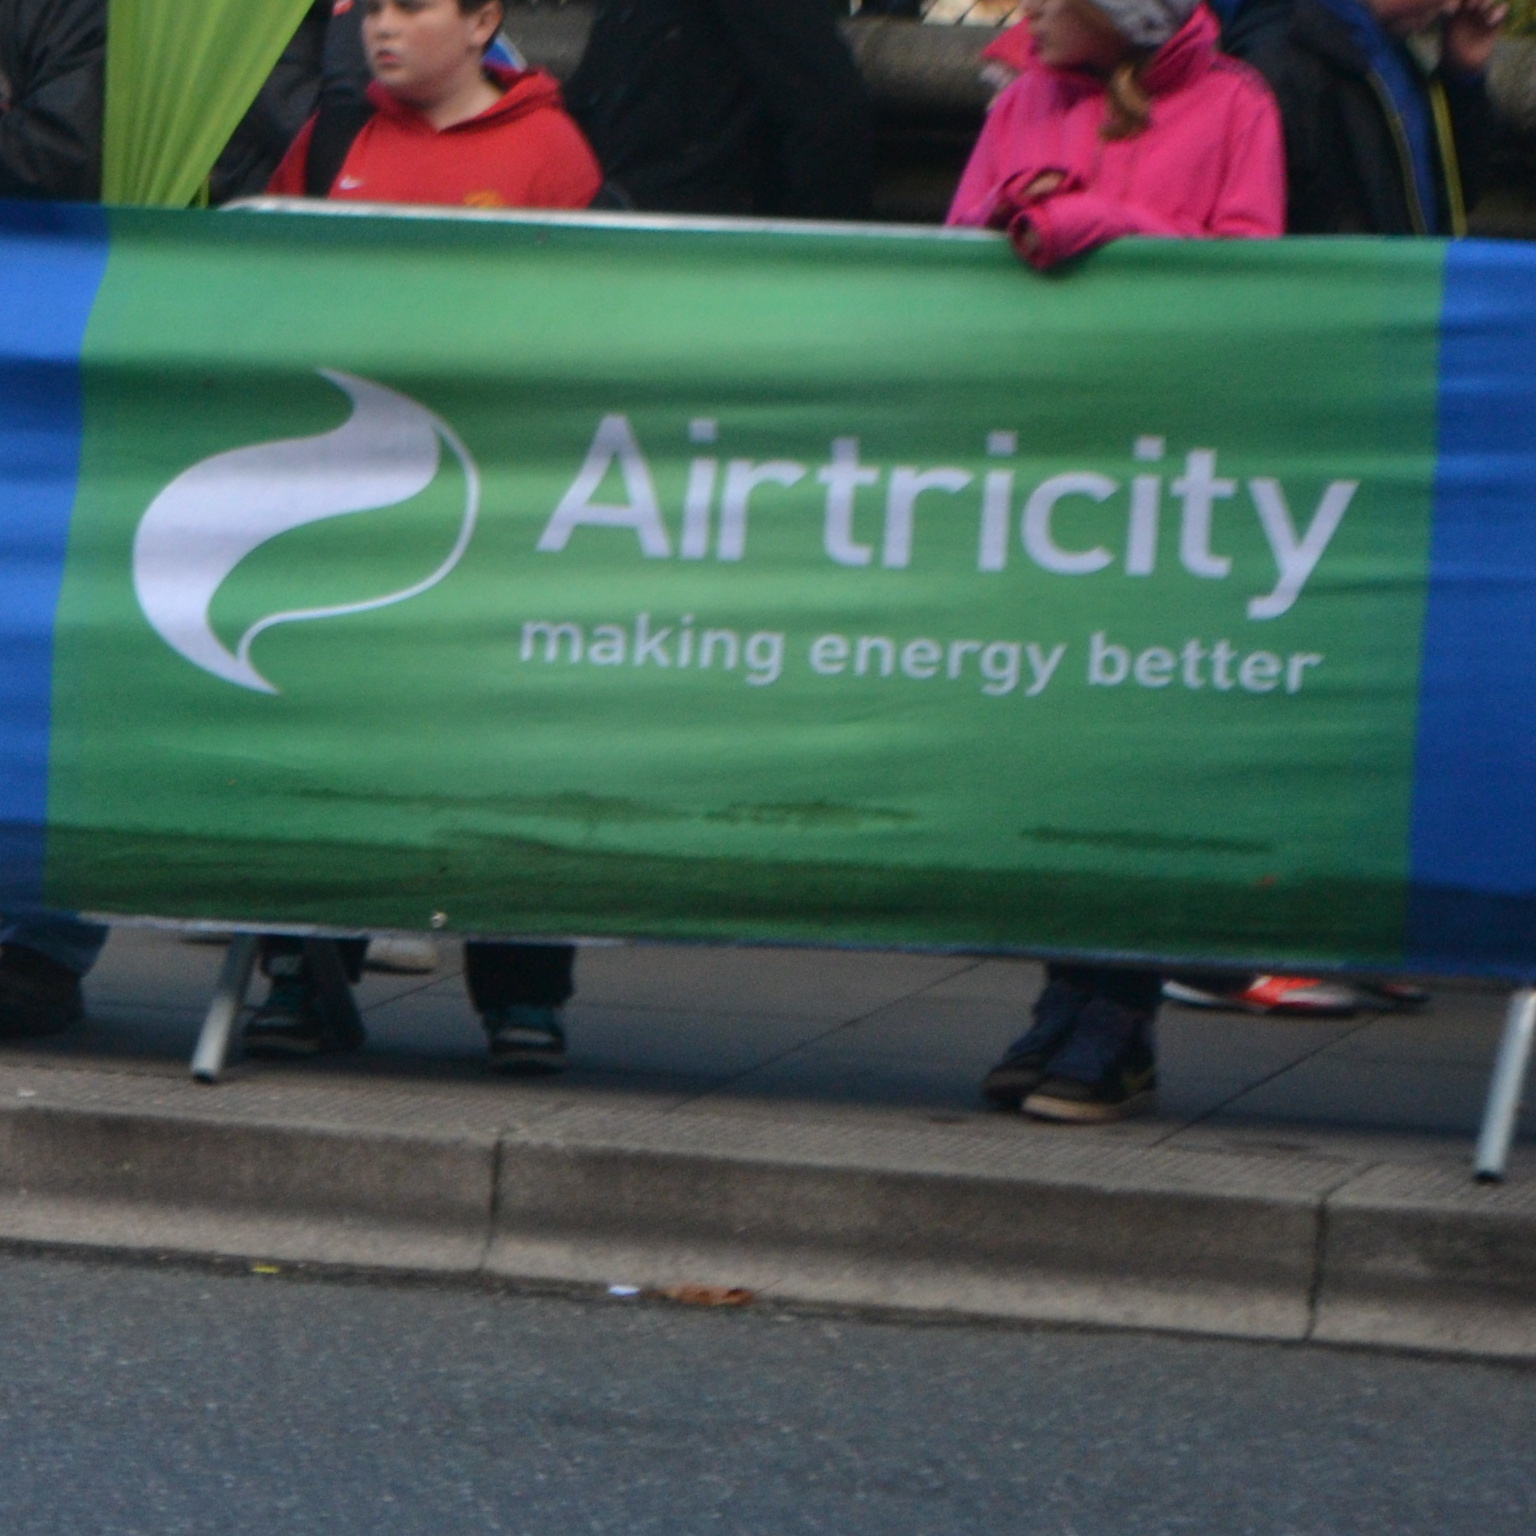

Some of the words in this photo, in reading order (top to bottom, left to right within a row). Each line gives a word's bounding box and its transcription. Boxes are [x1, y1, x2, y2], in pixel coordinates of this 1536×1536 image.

[535, 410, 1361, 619] Airtricity
[518, 611, 784, 686] making
[807, 626, 1069, 698] energy
[1087, 627, 1322, 695] better
